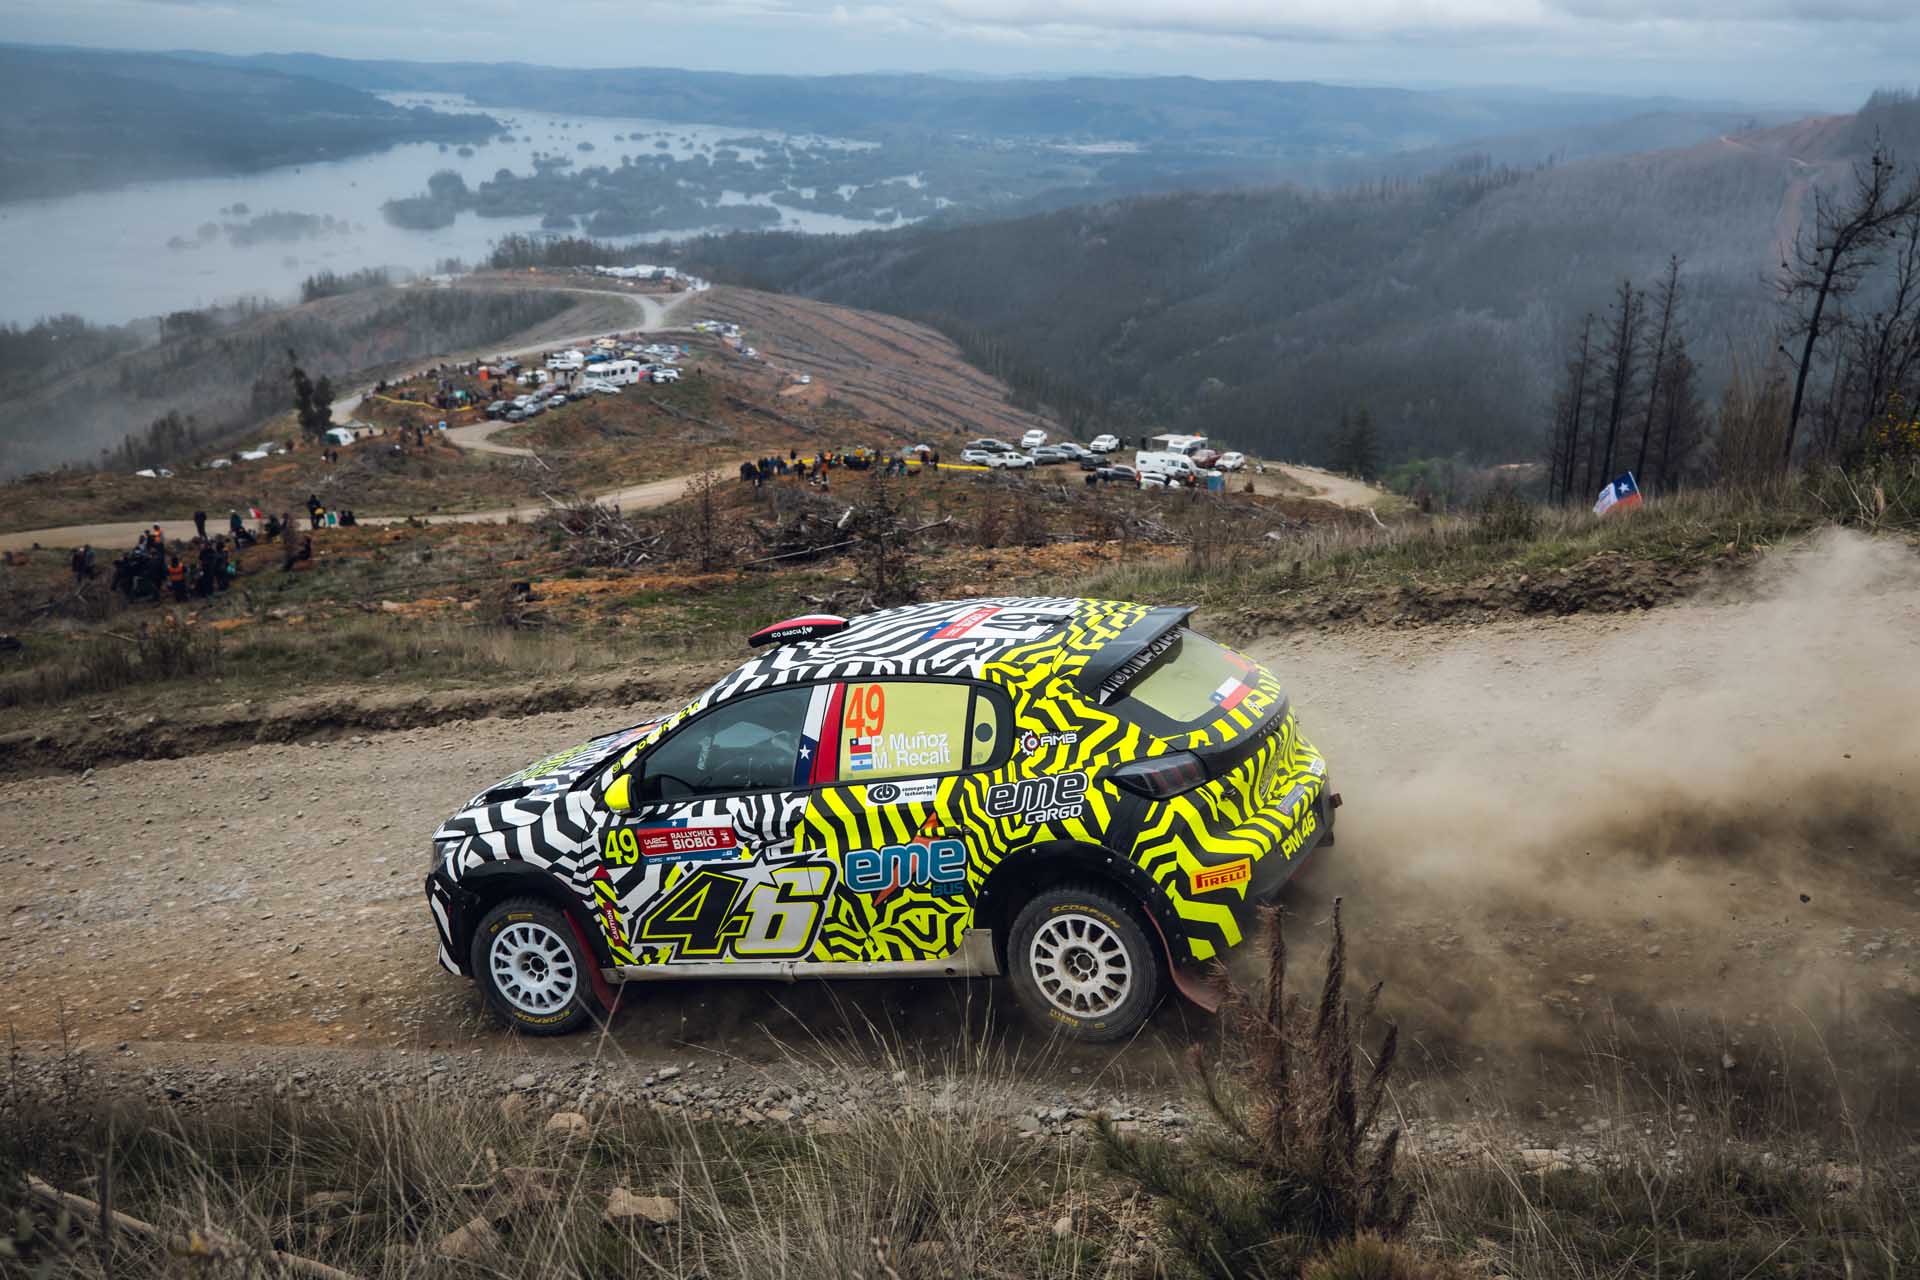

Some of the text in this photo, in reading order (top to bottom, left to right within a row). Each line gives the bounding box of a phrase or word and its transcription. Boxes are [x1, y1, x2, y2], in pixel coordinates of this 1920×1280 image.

[845, 683, 886, 738] 49
[871, 731, 949, 751] P. Muñoz
[1040, 733, 1078, 747] AMB
[872, 748, 951, 770] M. Recalt
[985, 772, 1088, 818] eme
[604, 828, 639, 865] 49
[1281, 828, 1304, 861] PM
[1302, 810, 1316, 838] 46
[844, 838, 967, 896] eme
[1195, 864, 1248, 889] PIRELLI
[932, 881, 965, 897] BUS
[606, 909, 620, 940] CAUTION
[632, 860, 839, 960] 46
